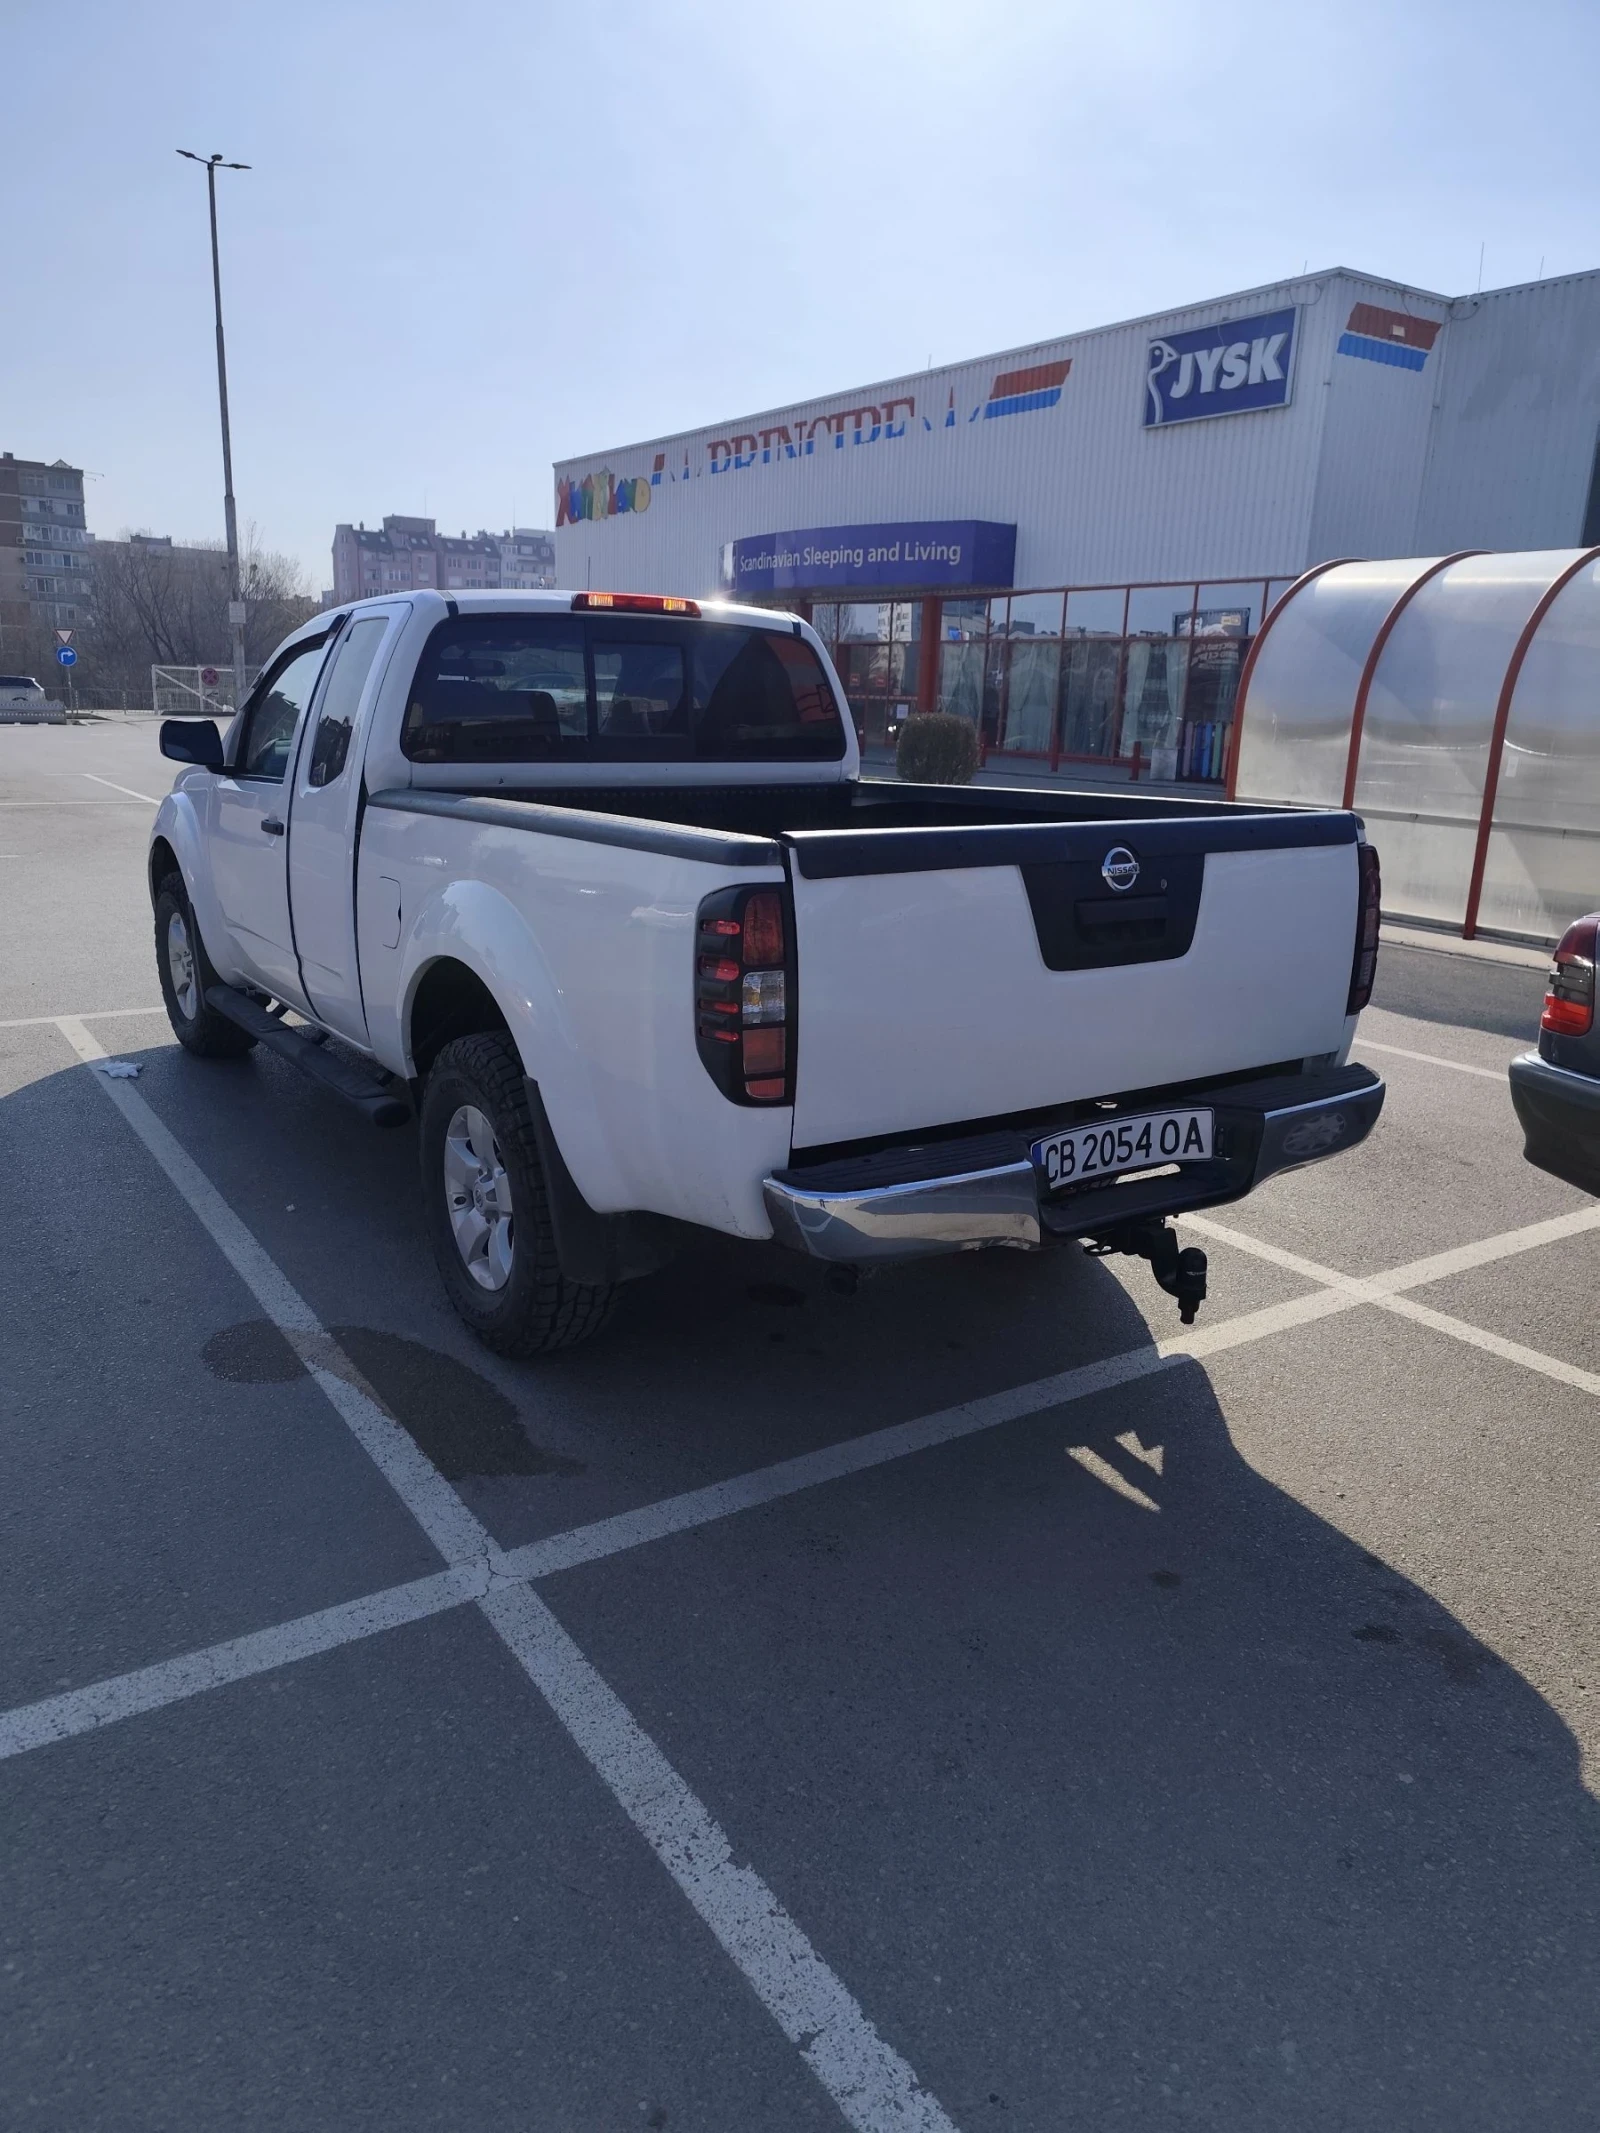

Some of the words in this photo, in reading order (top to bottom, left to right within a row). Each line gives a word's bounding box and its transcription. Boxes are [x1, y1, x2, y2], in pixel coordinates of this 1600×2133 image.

[1169, 332, 1288, 398] JYSK
[740, 550, 800, 573] Scandinavian
[803, 545, 863, 568] Sleeping
[868, 542, 899, 562] and
[904, 541, 961, 565] Living
[1107, 864, 1138, 875] NISSAN
[1046, 1139, 1075, 1184] CB
[1082, 1121, 1153, 1173] 2054
[1159, 1116, 1205, 1156] OA
